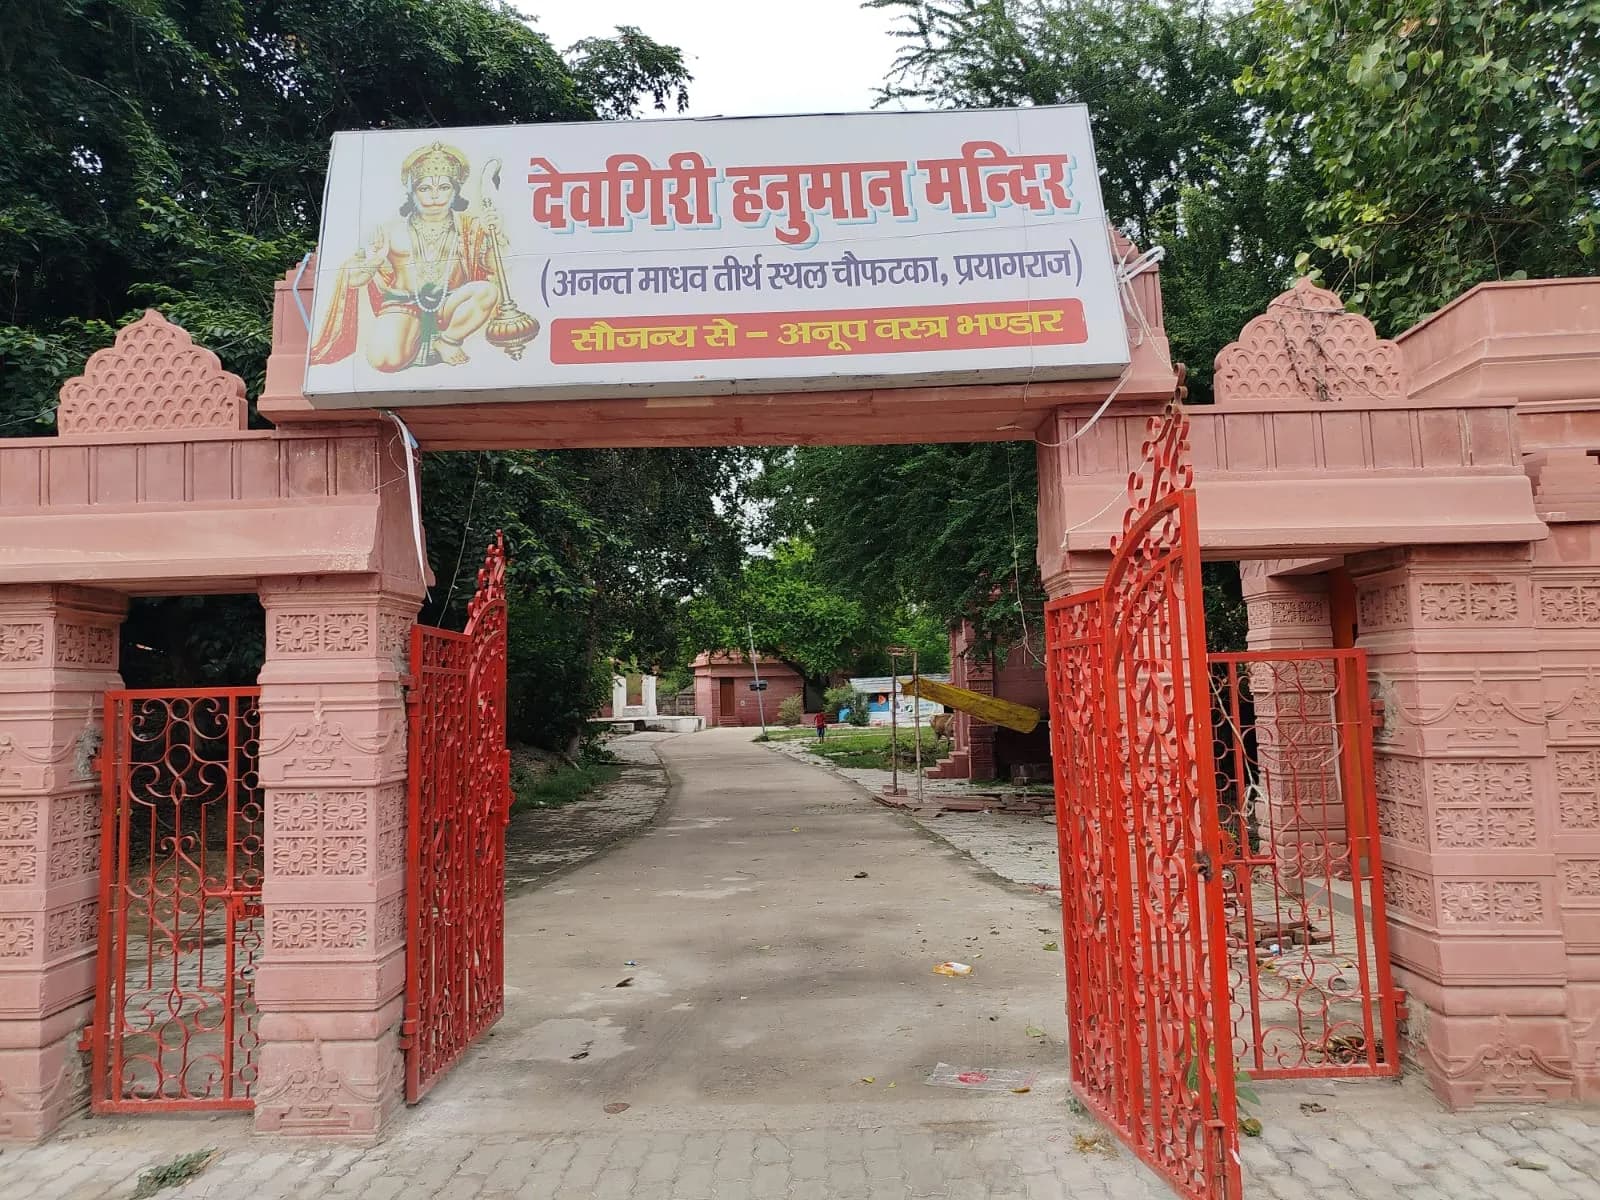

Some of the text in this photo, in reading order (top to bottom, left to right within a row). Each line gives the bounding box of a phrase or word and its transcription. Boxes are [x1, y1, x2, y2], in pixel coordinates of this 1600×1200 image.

[528, 140, 1072, 244] देवगिरी हनुमान मन्दिर
[541, 238, 1084, 307] (अनन्त माधव तीर्थ स्थल चौफटका, प्रयागराज)
[570, 320, 697, 352] सौजन्य
[703, 318, 739, 347] से
[777, 320, 868, 351] अनूप
[873, 315, 950, 341] वस्त्र
[956, 310, 1064, 336] भण्डार
